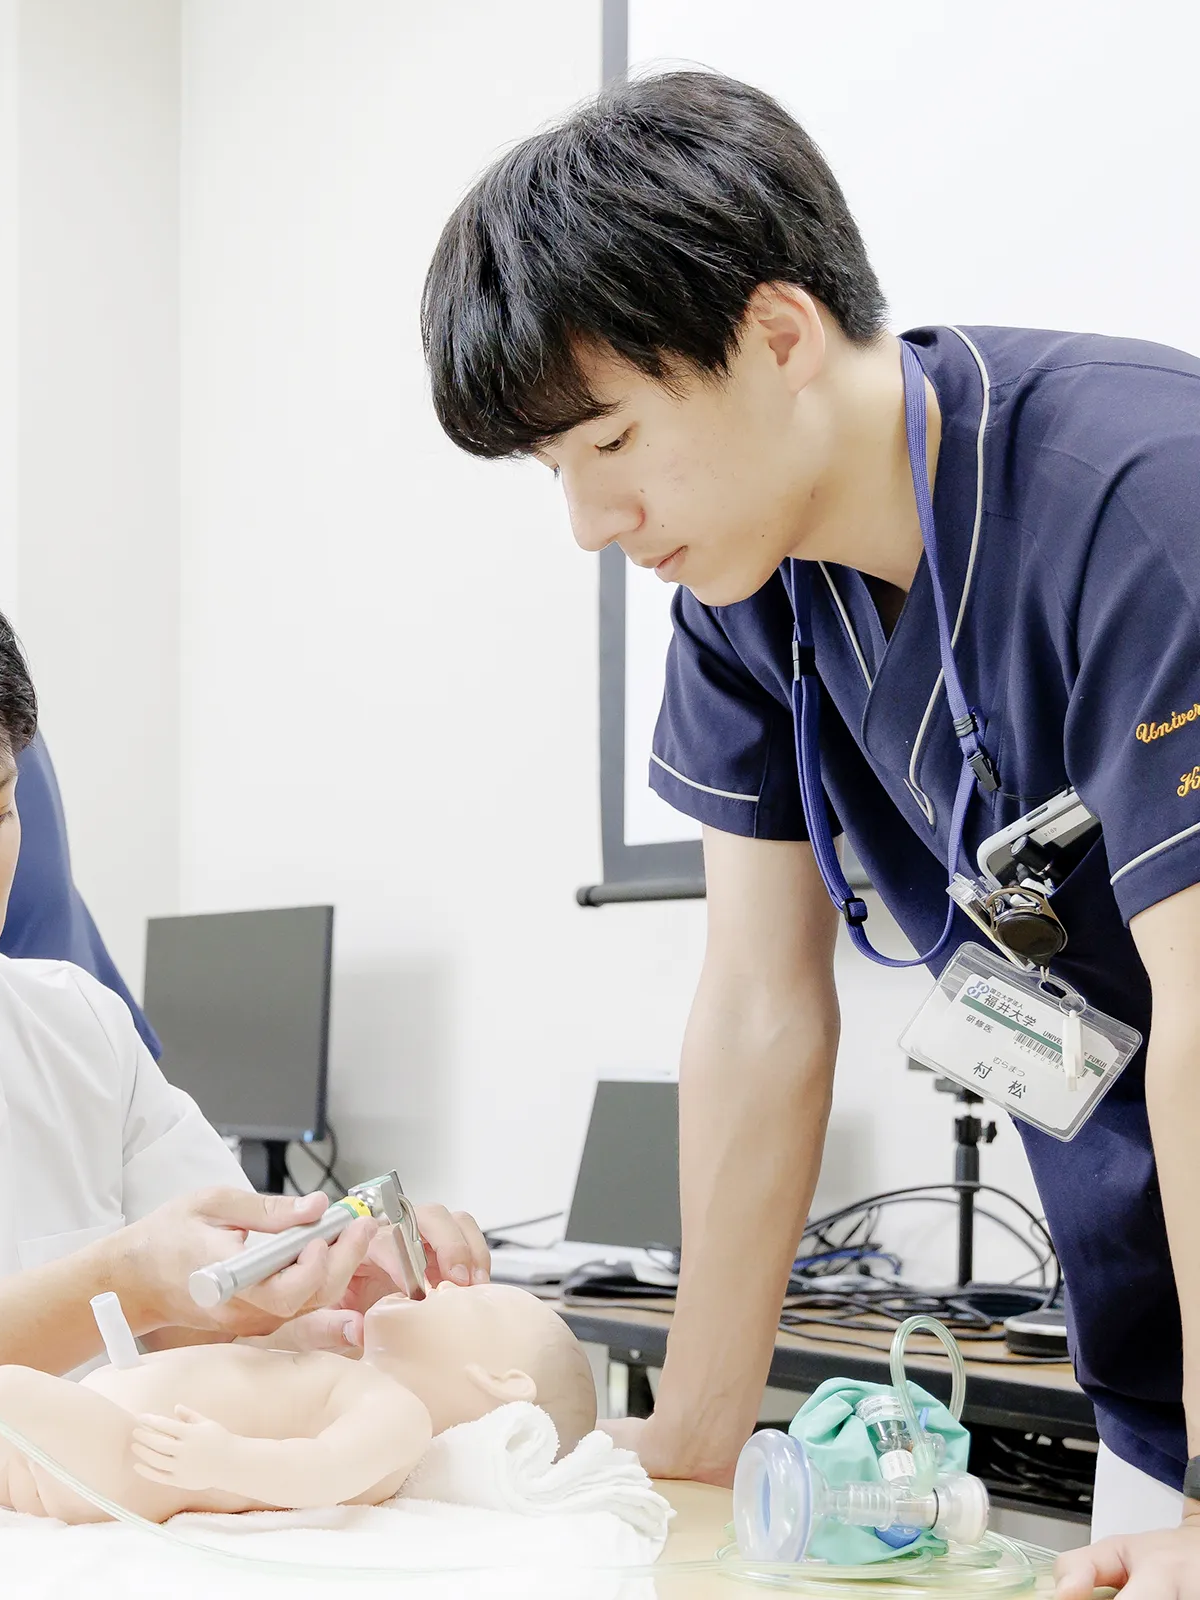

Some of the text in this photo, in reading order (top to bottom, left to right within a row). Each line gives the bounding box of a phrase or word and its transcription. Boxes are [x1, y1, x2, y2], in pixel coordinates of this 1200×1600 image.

[989, 987, 1024, 1009] 国立大学法人
[984, 995, 1037, 1027] 福井大学
[966, 1015, 994, 1033] 研修医
[1042, 1030, 1063, 1045] UNIVE
[1088, 1054, 1107, 1068] FUKUI
[992, 1056, 1026, 1077] むらまつ
